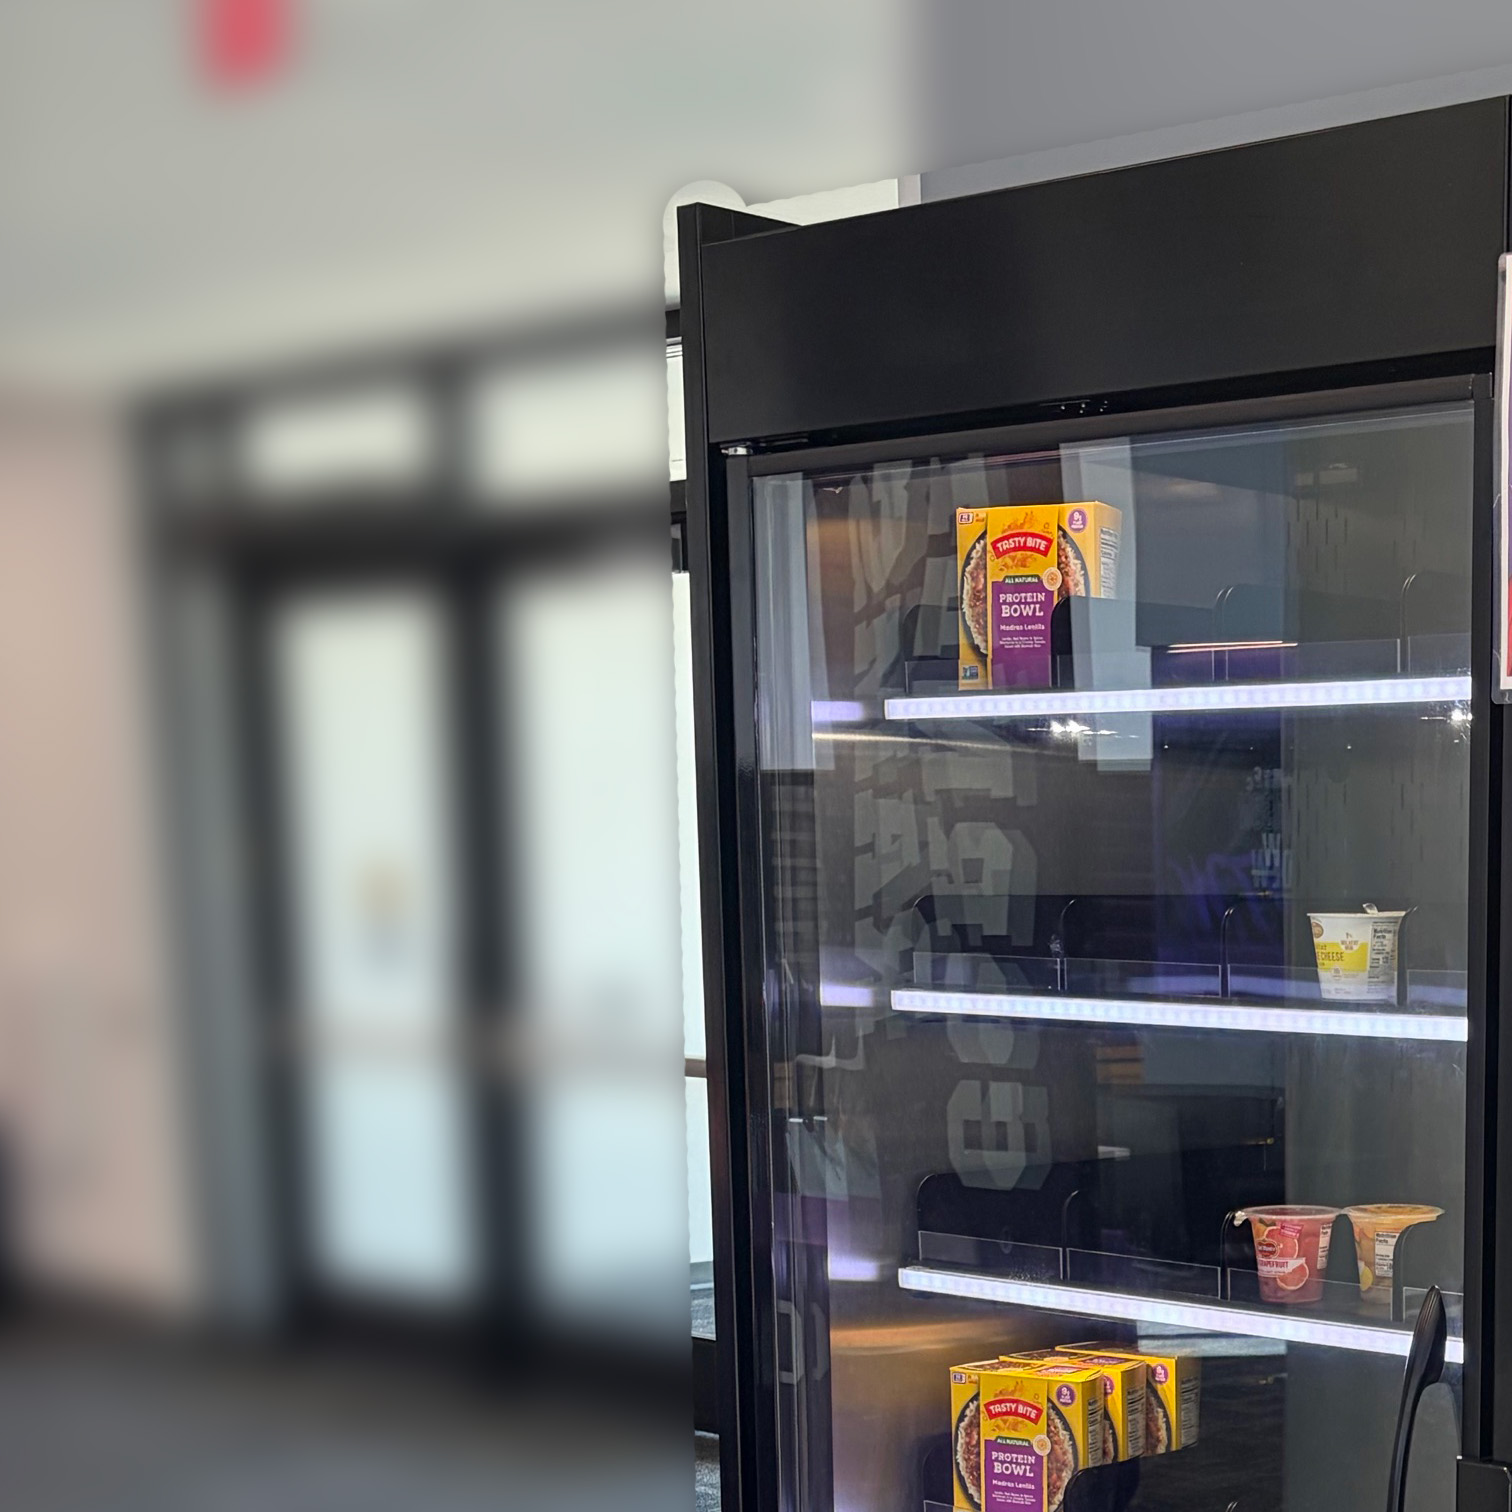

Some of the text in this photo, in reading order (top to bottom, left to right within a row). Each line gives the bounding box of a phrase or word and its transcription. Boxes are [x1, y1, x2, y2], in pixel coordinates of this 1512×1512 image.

[996, 536, 1048, 552] TASTY BITE
[999, 592, 1046, 603] PROTEIN
[1001, 604, 1044, 617] BOWL
[988, 1402, 1038, 1419] TASTY BITE
[1006, 1439, 1030, 1447] NATURAL
[991, 1451, 1036, 1464] PROTEIN
[993, 1461, 1034, 1477] BOWL
